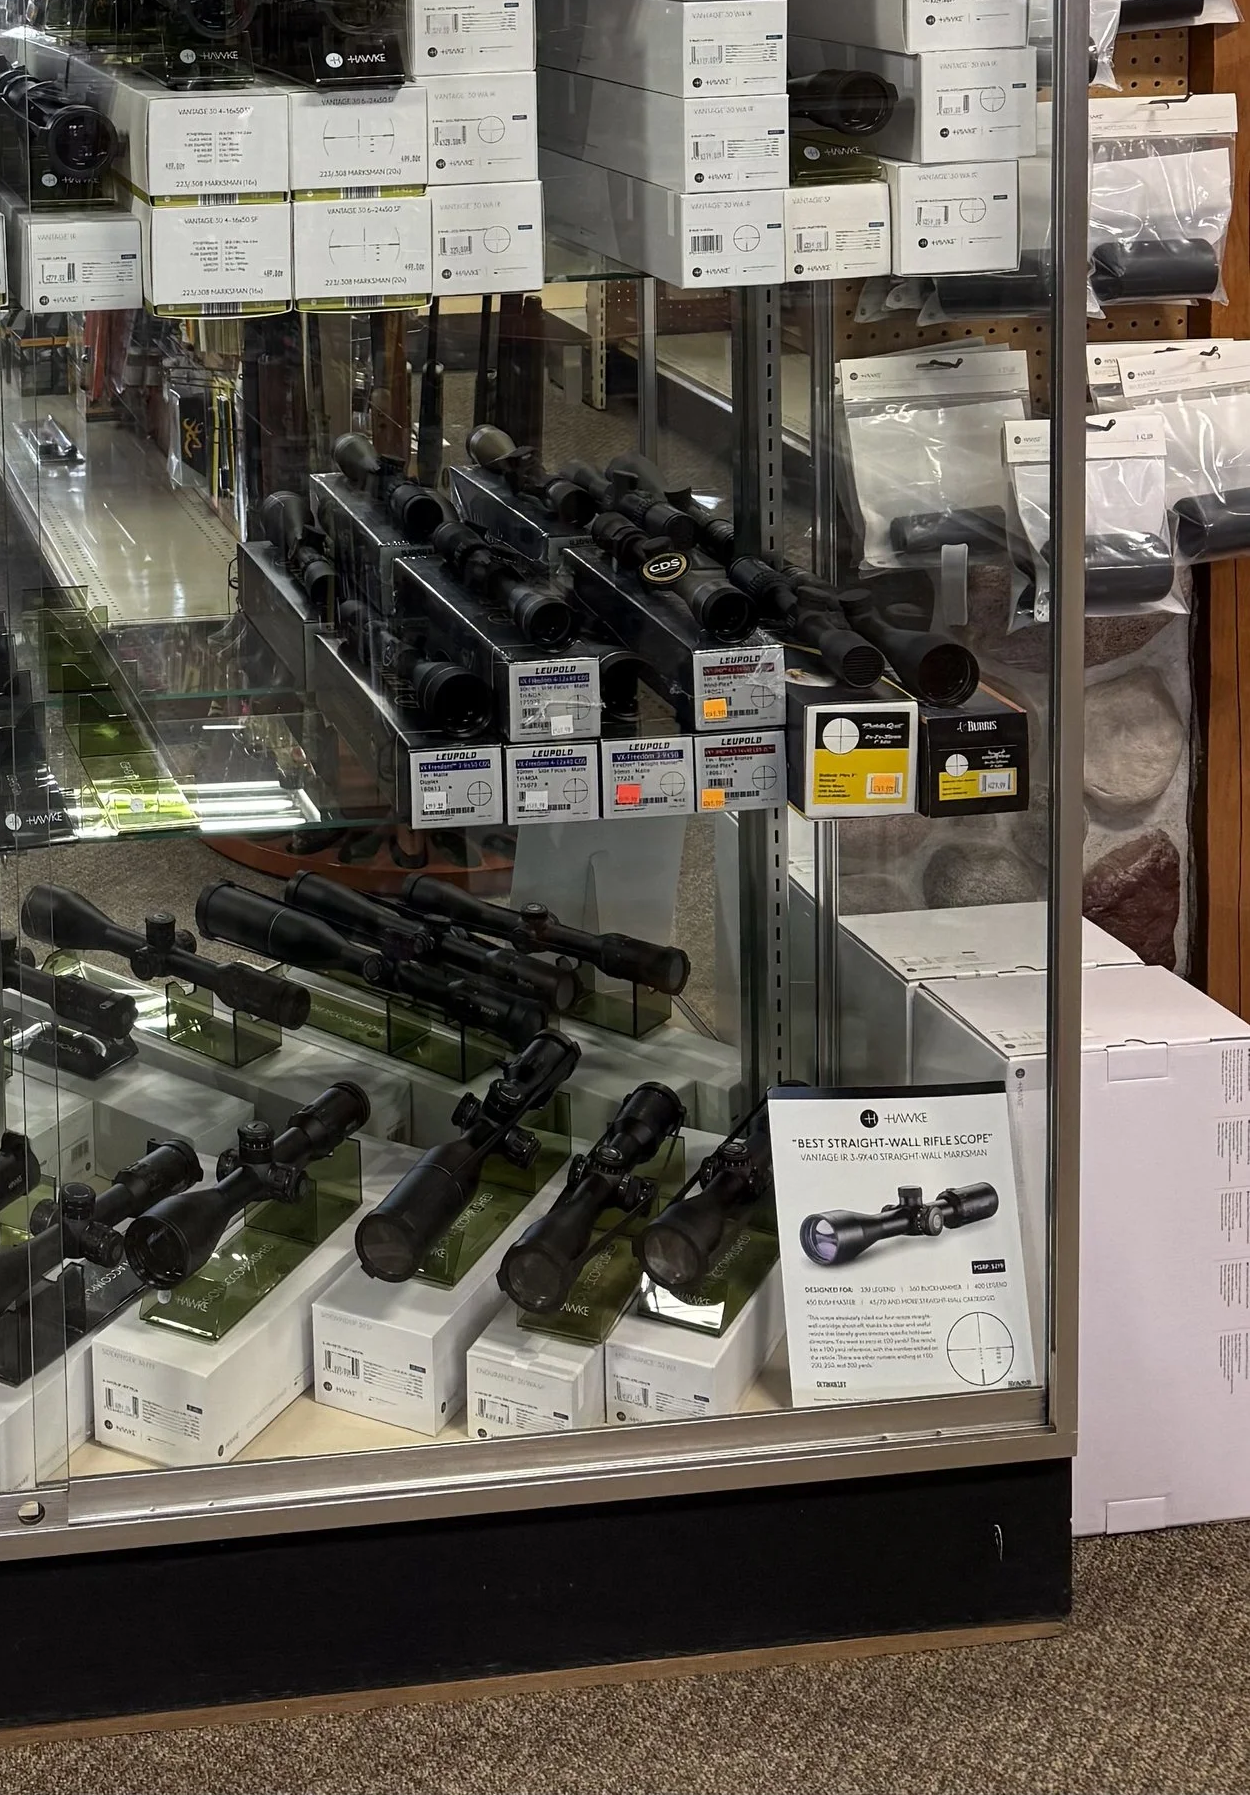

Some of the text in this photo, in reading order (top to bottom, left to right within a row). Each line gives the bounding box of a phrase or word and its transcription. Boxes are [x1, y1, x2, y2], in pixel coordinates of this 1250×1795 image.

[347, 54, 386, 63] HAWKE
[649, 558, 680, 572] CDS
[719, 655, 761, 664] LEUPOLD
[535, 666, 576, 675] LEUPOLD
[967, 720, 997, 732] BURRIS
[721, 737, 762, 745] LEUPOLD
[629, 741, 670, 751] LEUPOLD
[436, 752, 477, 761] LEUPOLD
[532, 749, 573, 757] LEUPOLD
[884, 1112, 928, 1124] HAWKE
[828, 1137, 921, 1148] STRAIGHT-WALL
[923, 1135, 952, 1146] RIFLE
[800, 1153, 839, 1162] VANTAGE
[840, 1153, 848, 1161] IR
[880, 1151, 942, 1160] STRAIGHT-WALL
[944, 1149, 987, 1159] MARKSMAN
